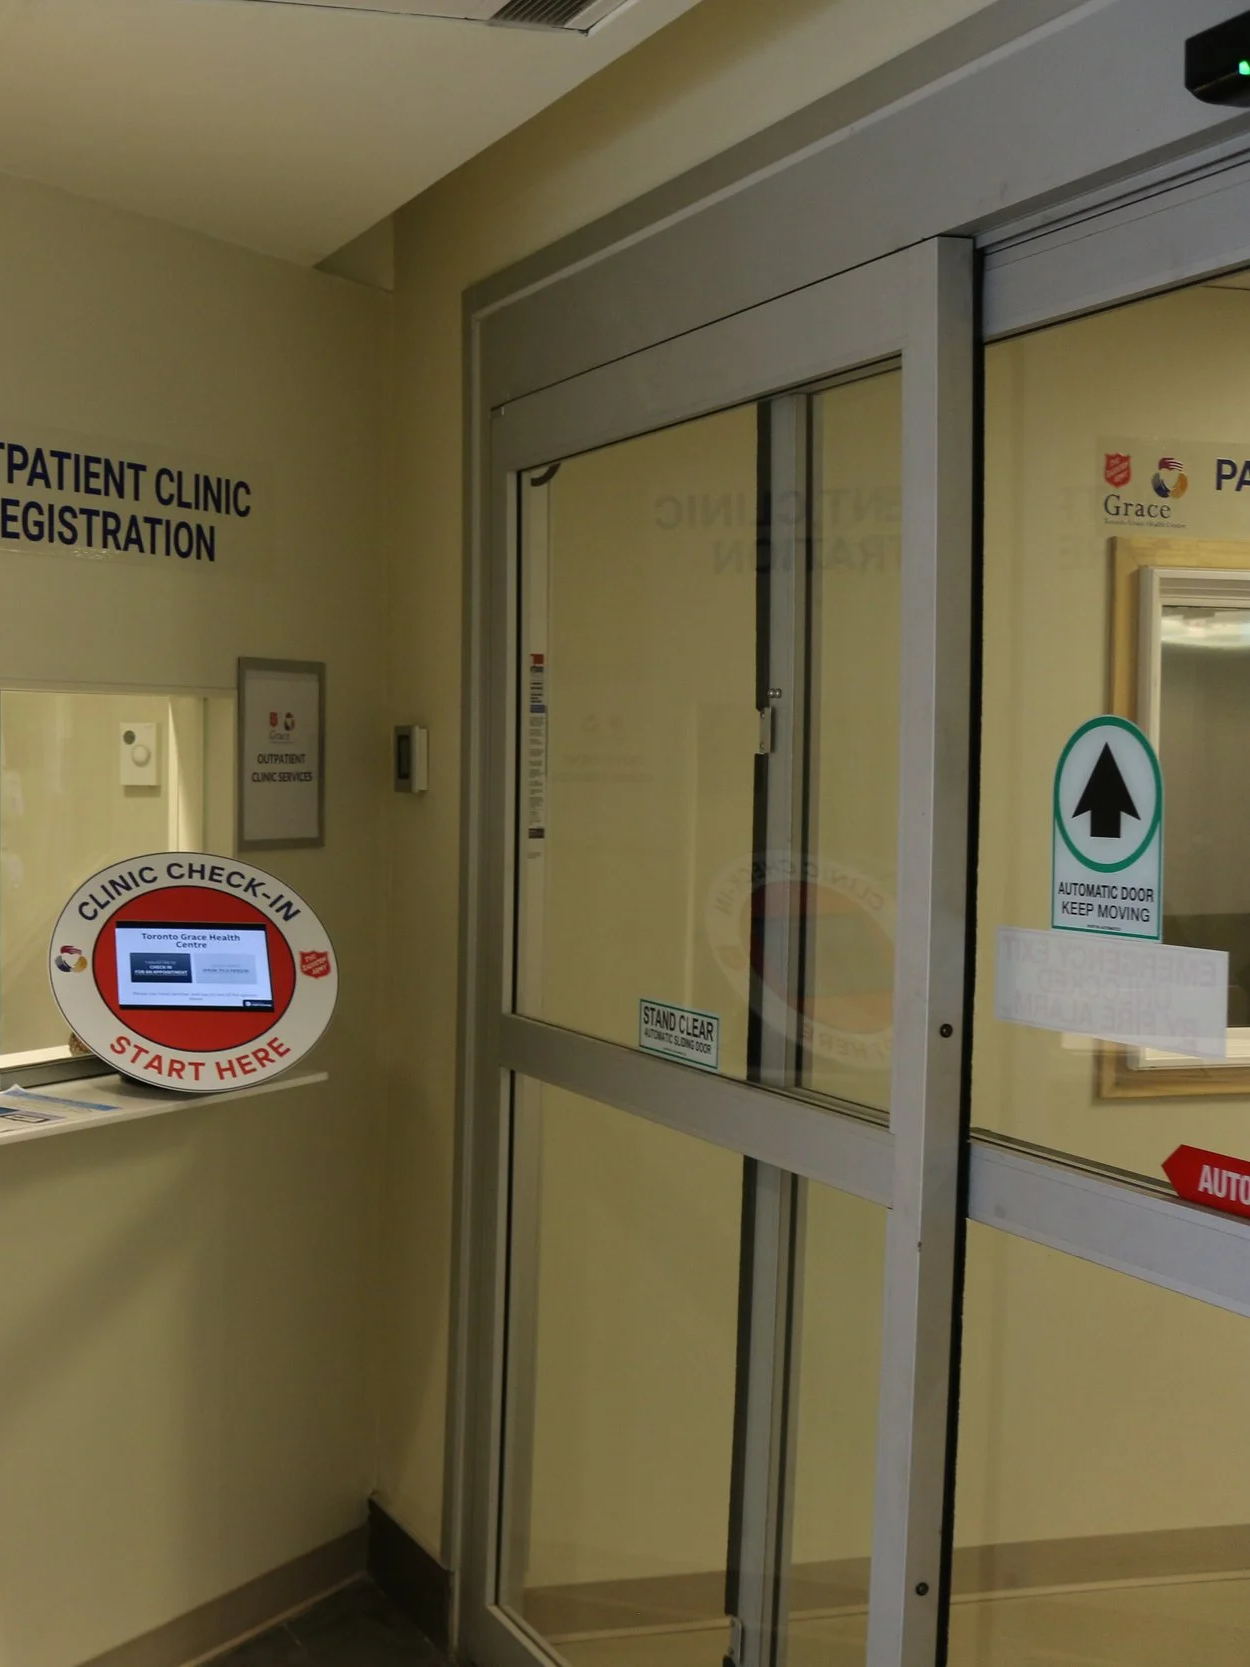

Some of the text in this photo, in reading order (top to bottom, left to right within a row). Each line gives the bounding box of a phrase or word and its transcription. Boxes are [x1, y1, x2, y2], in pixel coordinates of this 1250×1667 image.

[155, 467, 252, 518] CLINIC
[1103, 493, 1171, 519] Grace
[257, 753, 306, 764] OUTPATIENT
[252, 771, 312, 783] CLINIC SERVICES
[78, 862, 301, 923] CLINIC CHECK-IN
[1058, 881, 1154, 903] AUTOMATIC DOOR
[1061, 901, 1150, 923] KEEP MOVING
[141, 933, 241, 942] Toronto Grace Health
[176, 941, 208, 949] Centre
[643, 1005, 714, 1042] STAND CLEAR
[674, 1035, 694, 1050] SLIDING
[695, 1041, 712, 1054] DOOR
[109, 1036, 292, 1081] START HERE
[1197, 1164, 1250, 1206] AUTO
